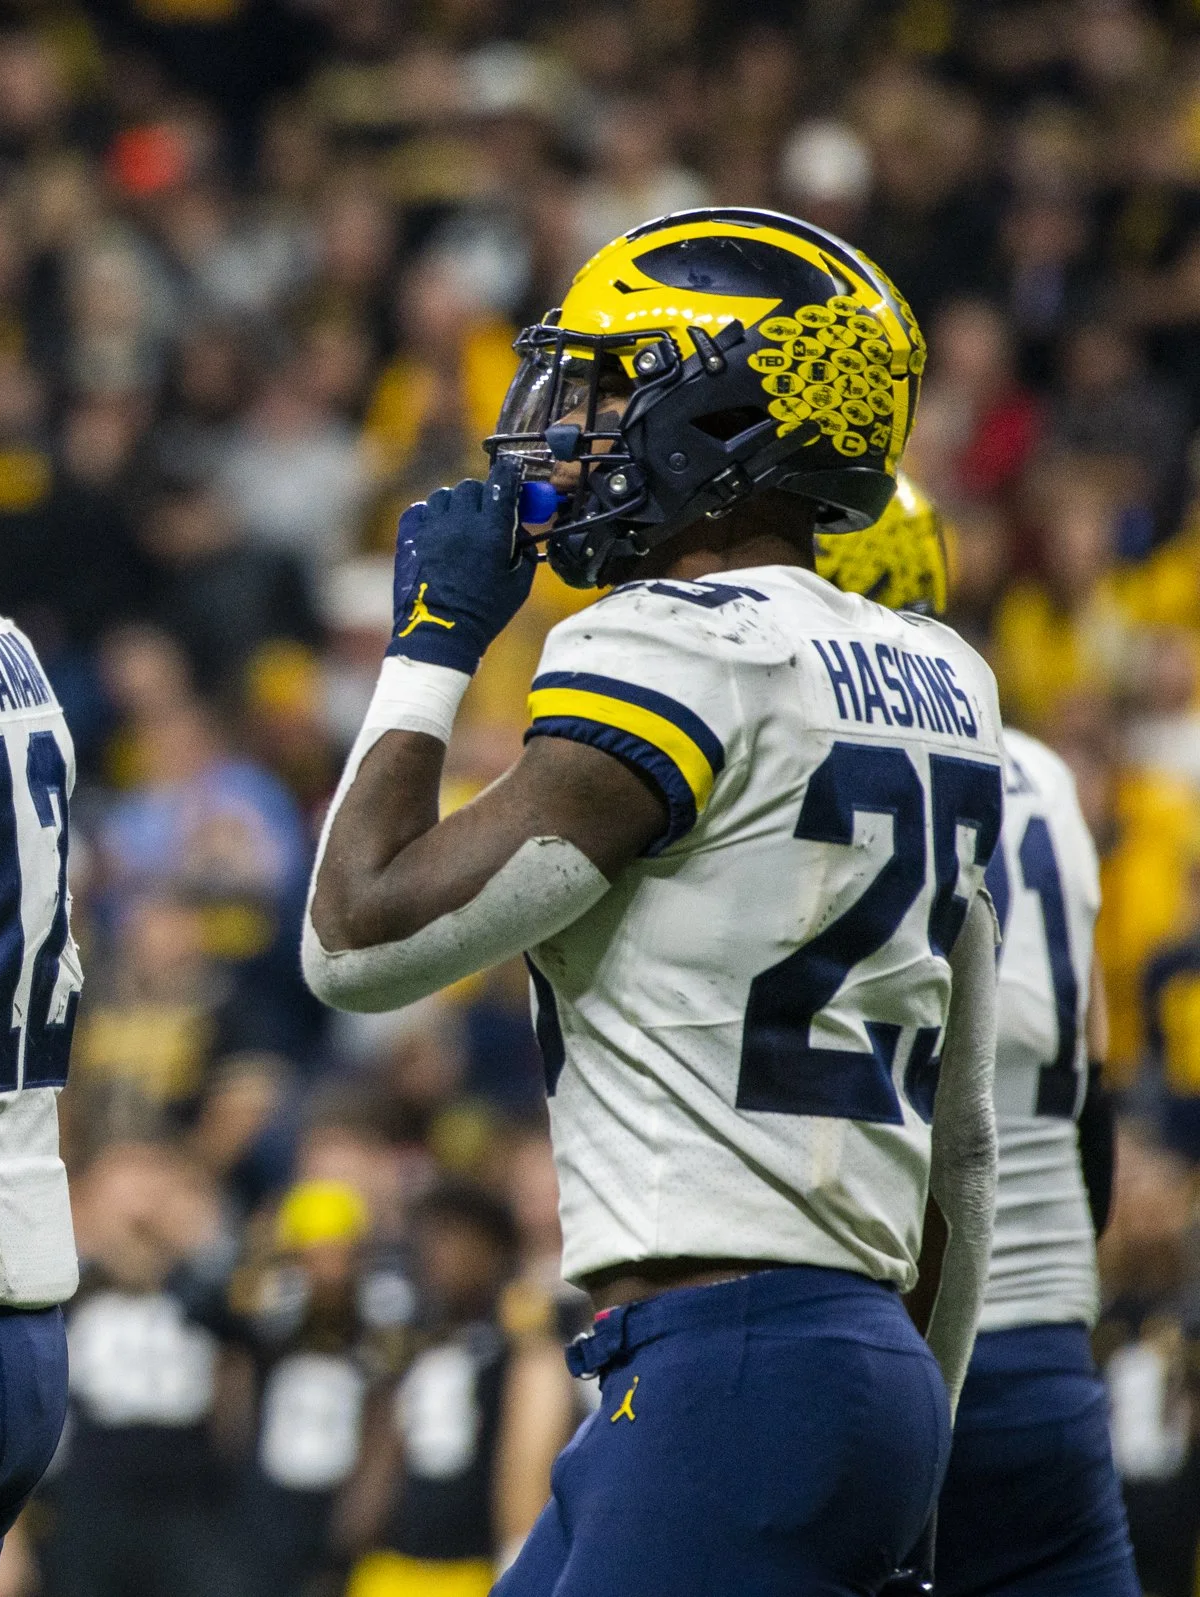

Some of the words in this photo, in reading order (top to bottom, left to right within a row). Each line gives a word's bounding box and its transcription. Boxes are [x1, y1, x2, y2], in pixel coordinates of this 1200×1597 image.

[757, 356, 784, 367] TED
[869, 421, 892, 449] 25
[811, 639, 978, 739] HASKINS
[736, 741, 1003, 1126] 25
